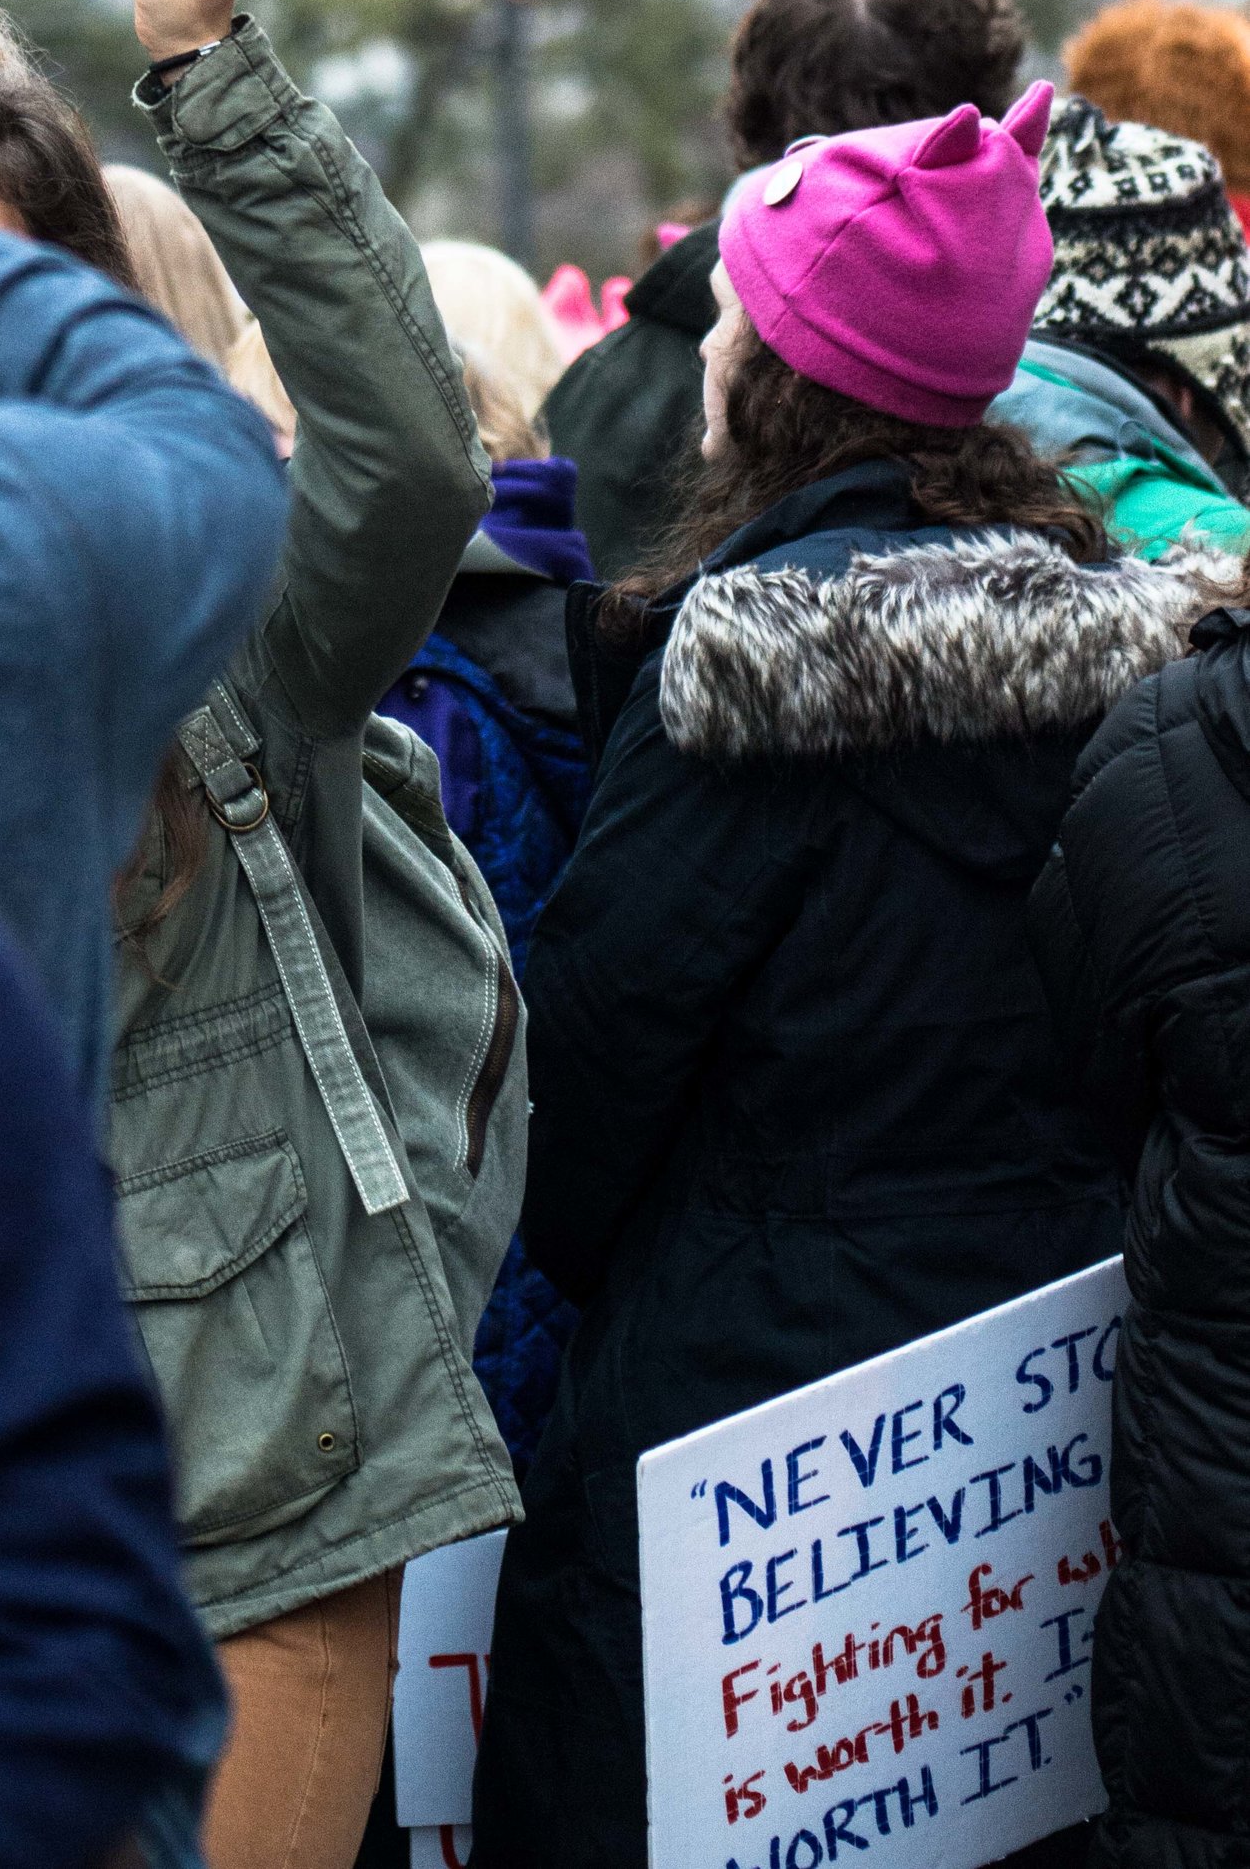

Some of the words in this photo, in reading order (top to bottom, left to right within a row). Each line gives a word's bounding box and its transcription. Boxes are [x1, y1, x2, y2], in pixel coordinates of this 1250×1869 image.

[719, 1432, 1103, 1646] BELIEVING
[720, 1612, 947, 1739] Fighting
[960, 1562, 1036, 1630] for
[722, 1769, 767, 1826] is
[783, 1692, 940, 1794] worth
[956, 1651, 1013, 1719] it.
